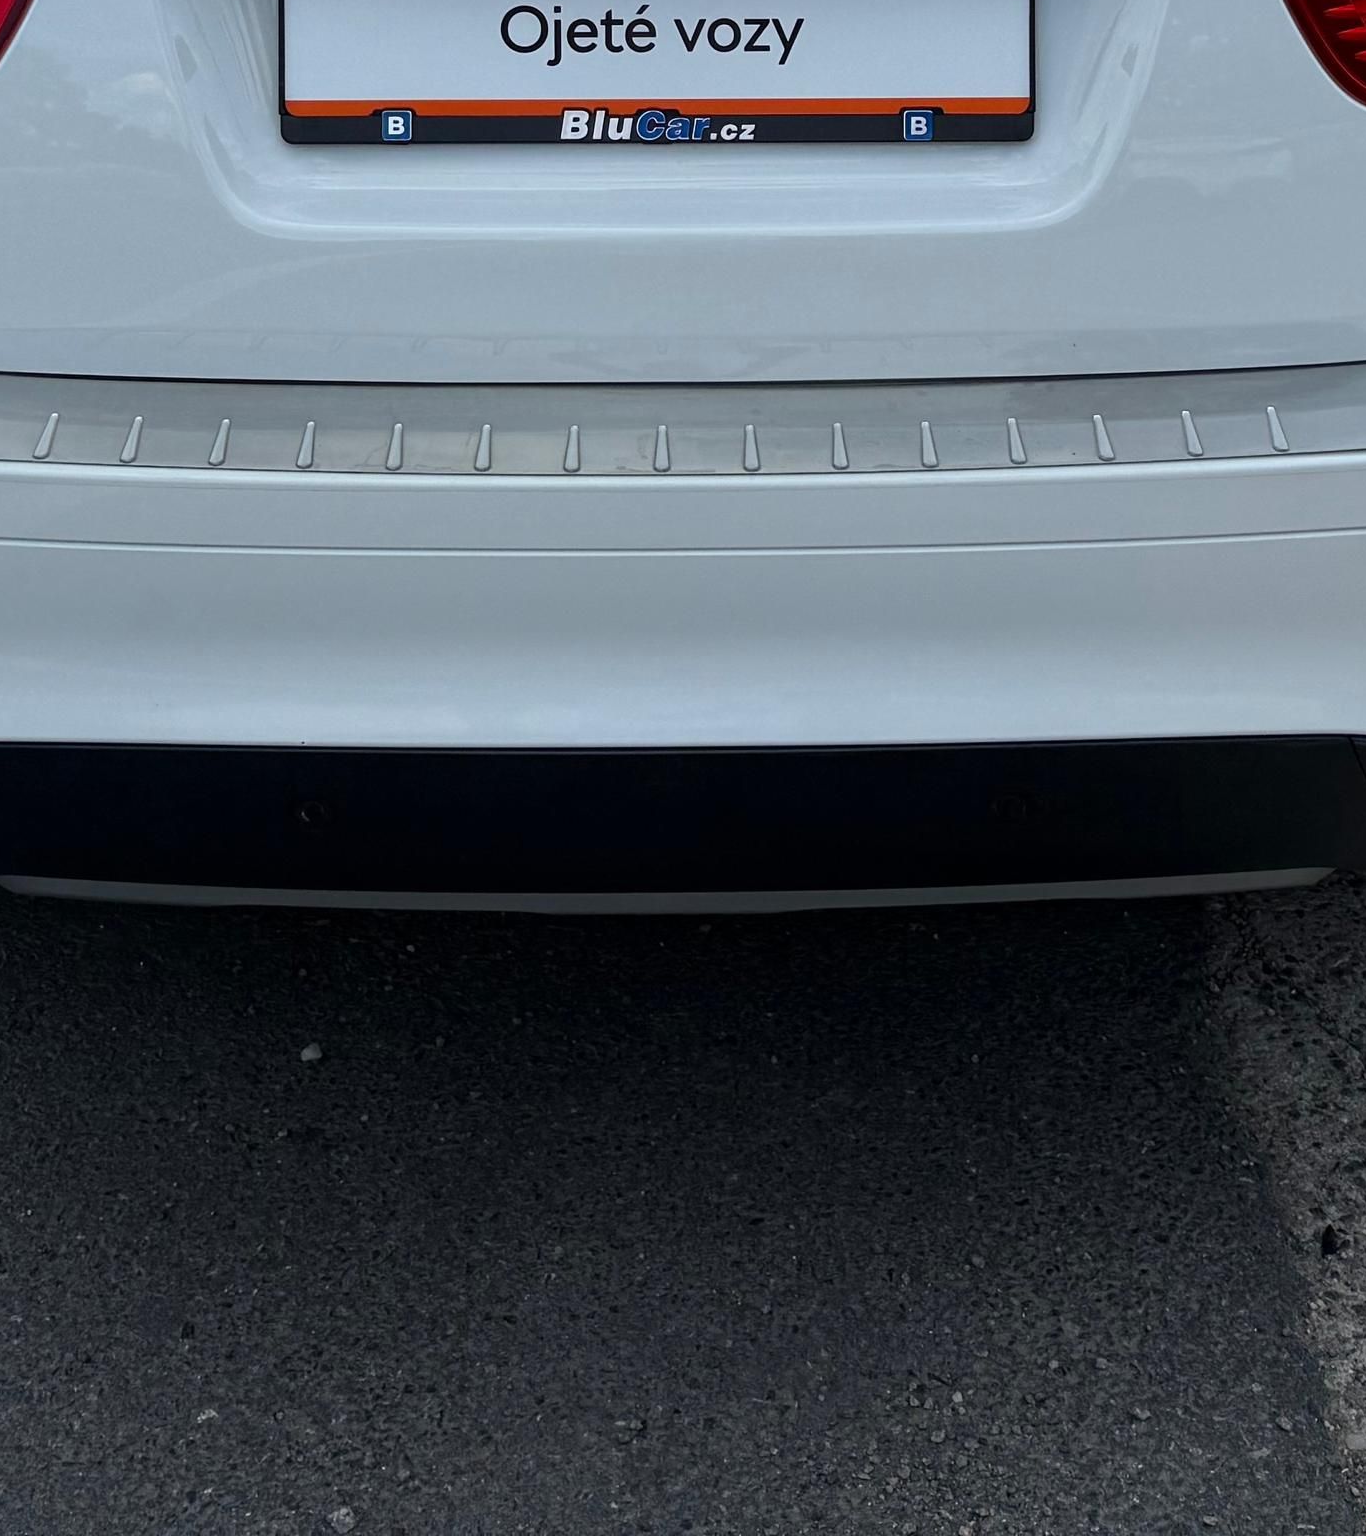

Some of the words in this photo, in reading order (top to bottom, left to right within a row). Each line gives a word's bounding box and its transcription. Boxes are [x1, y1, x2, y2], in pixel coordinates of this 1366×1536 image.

[500, 4, 657, 66] Ojeté
[673, 18, 804, 65] vozy
[388, 116, 405, 135] B
[560, 110, 756, 141] BluCar.cz
[910, 116, 928, 135] B
